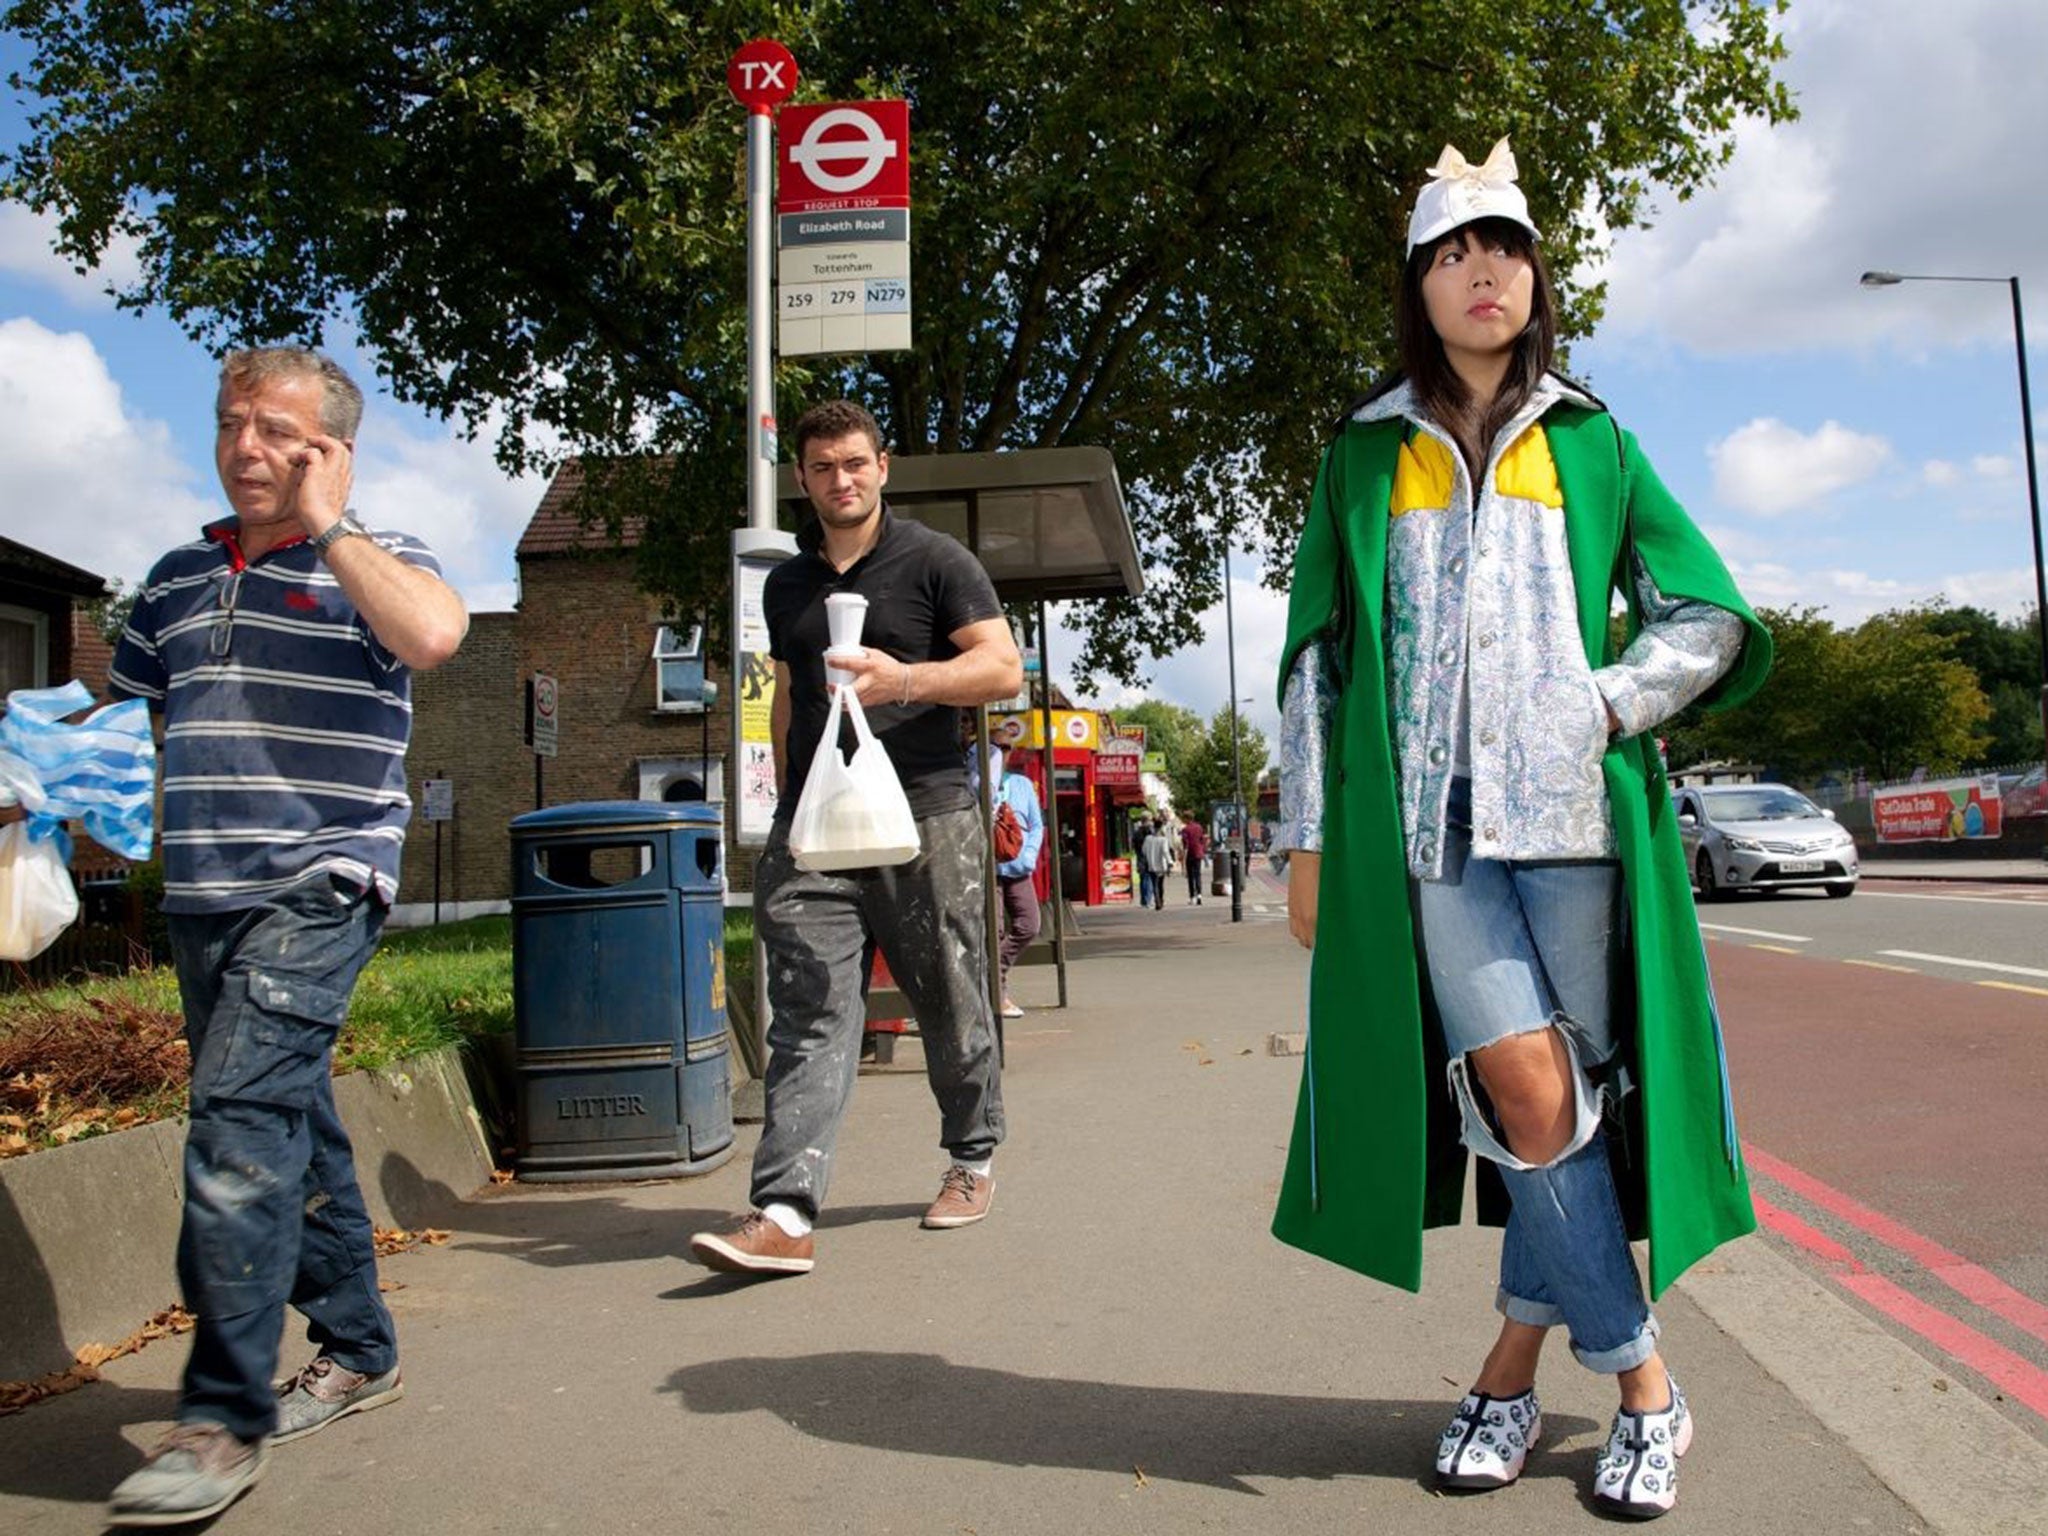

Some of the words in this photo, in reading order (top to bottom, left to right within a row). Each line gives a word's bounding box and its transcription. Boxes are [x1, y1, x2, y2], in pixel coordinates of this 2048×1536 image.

[738, 61, 785, 90] TX
[804, 200, 849, 210] REQUEST
[853, 199, 880, 208] STOP
[799, 220, 852, 235] Elizabeth
[855, 219, 885, 231] Road
[812, 262, 873, 275] Tottenham
[787, 293, 813, 308] 259
[831, 289, 856, 305] 279
[867, 287, 906, 303] N279
[557, 1094, 648, 1120] LITTER
